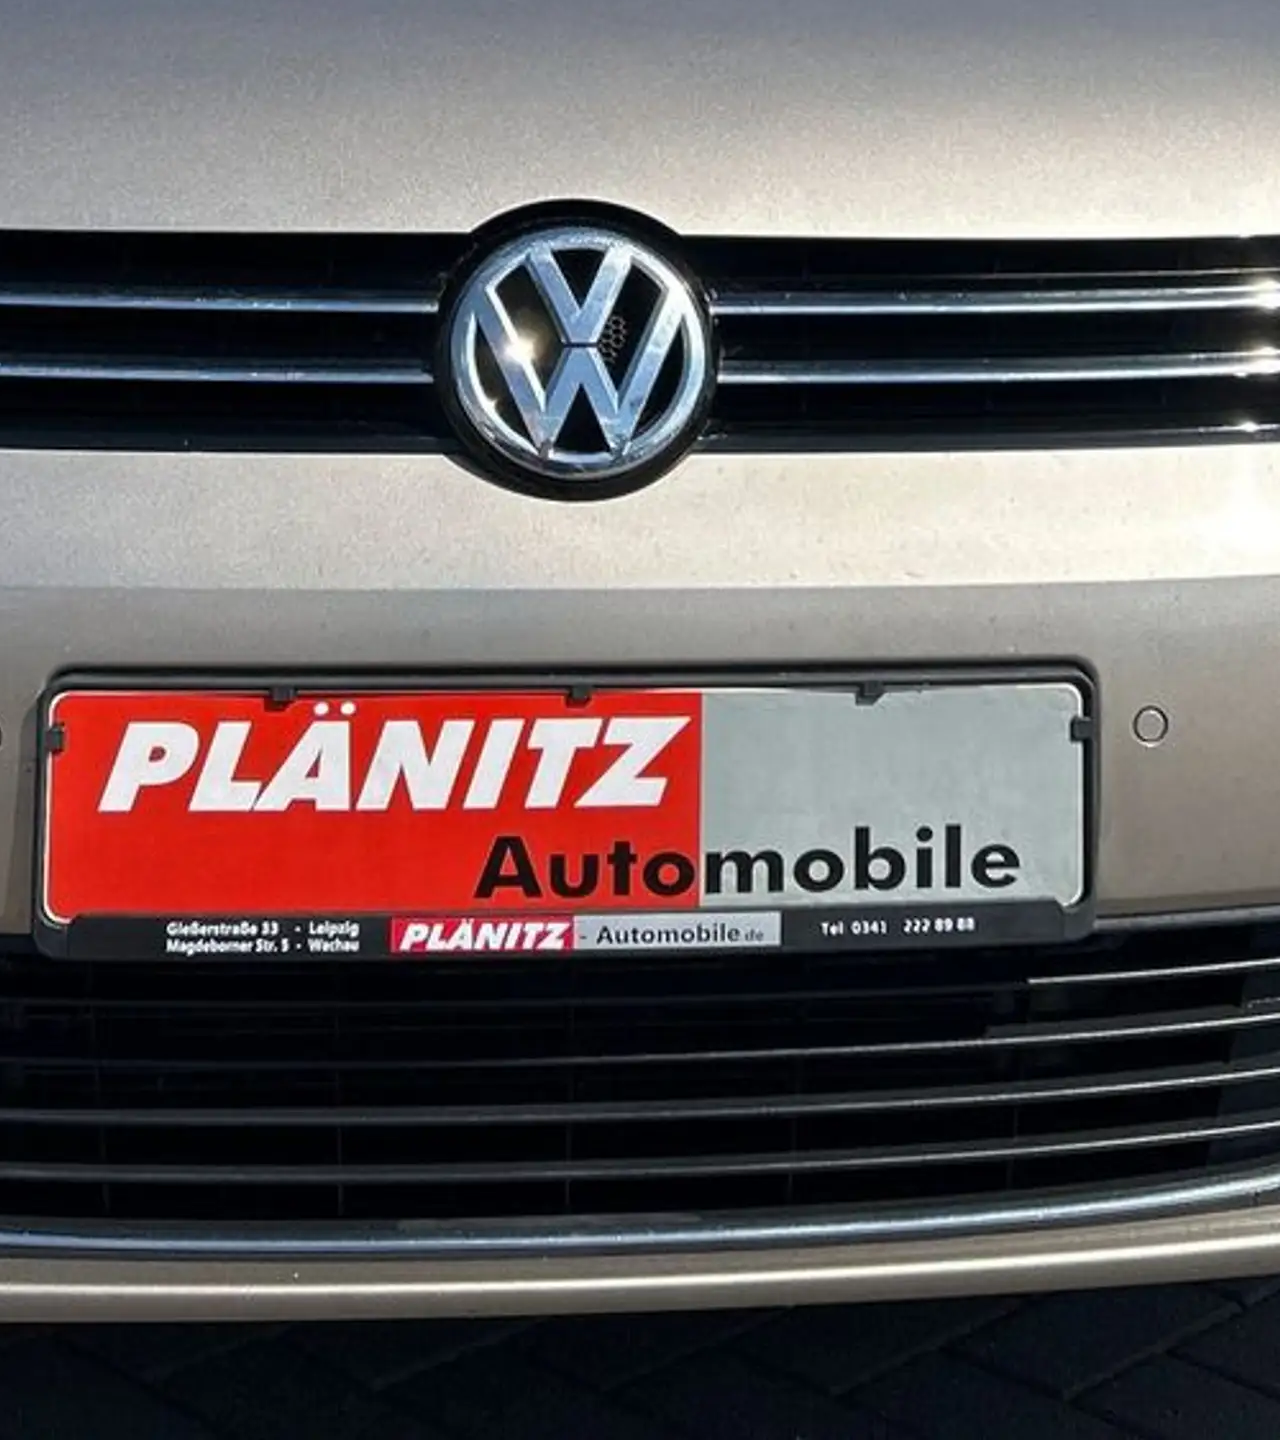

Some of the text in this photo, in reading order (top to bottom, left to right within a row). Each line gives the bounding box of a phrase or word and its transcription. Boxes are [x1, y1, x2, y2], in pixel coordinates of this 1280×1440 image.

[98, 702, 690, 814] PLÄNITZ
[474, 825, 1020, 899] Automobile
[309, 921, 360, 938] Leipzig
[399, 918, 571, 950] PLÄNITZ
[851, 920, 887, 935] 0341
[904, 918, 931, 933] 222
[307, 938, 360, 953] Wachau
